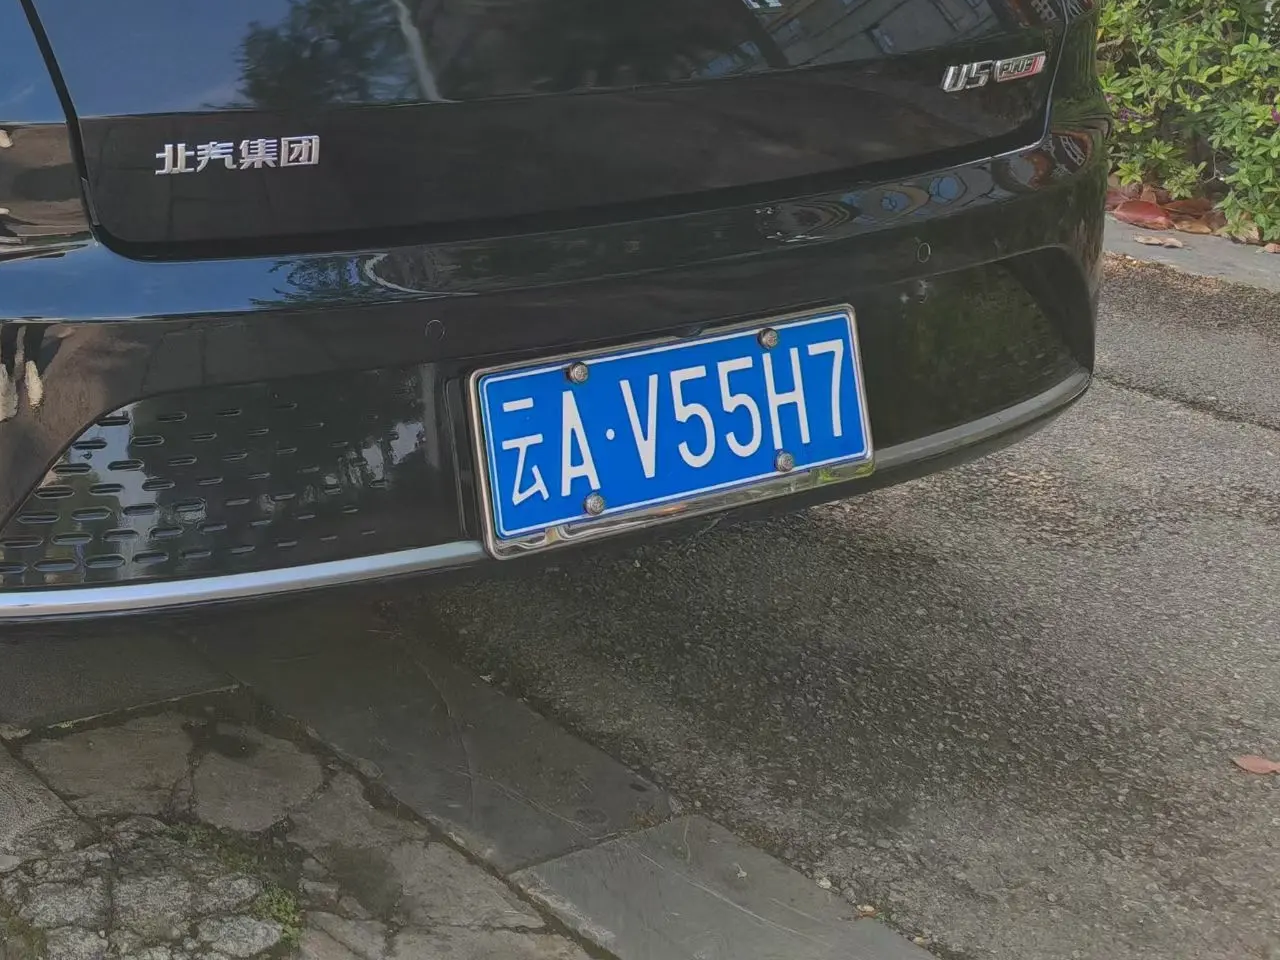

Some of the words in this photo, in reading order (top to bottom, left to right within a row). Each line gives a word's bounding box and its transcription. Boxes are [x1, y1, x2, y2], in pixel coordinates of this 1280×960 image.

[154, 135, 320, 176] 北汽集团
[502, 338, 845, 507] 云A·V55H7
